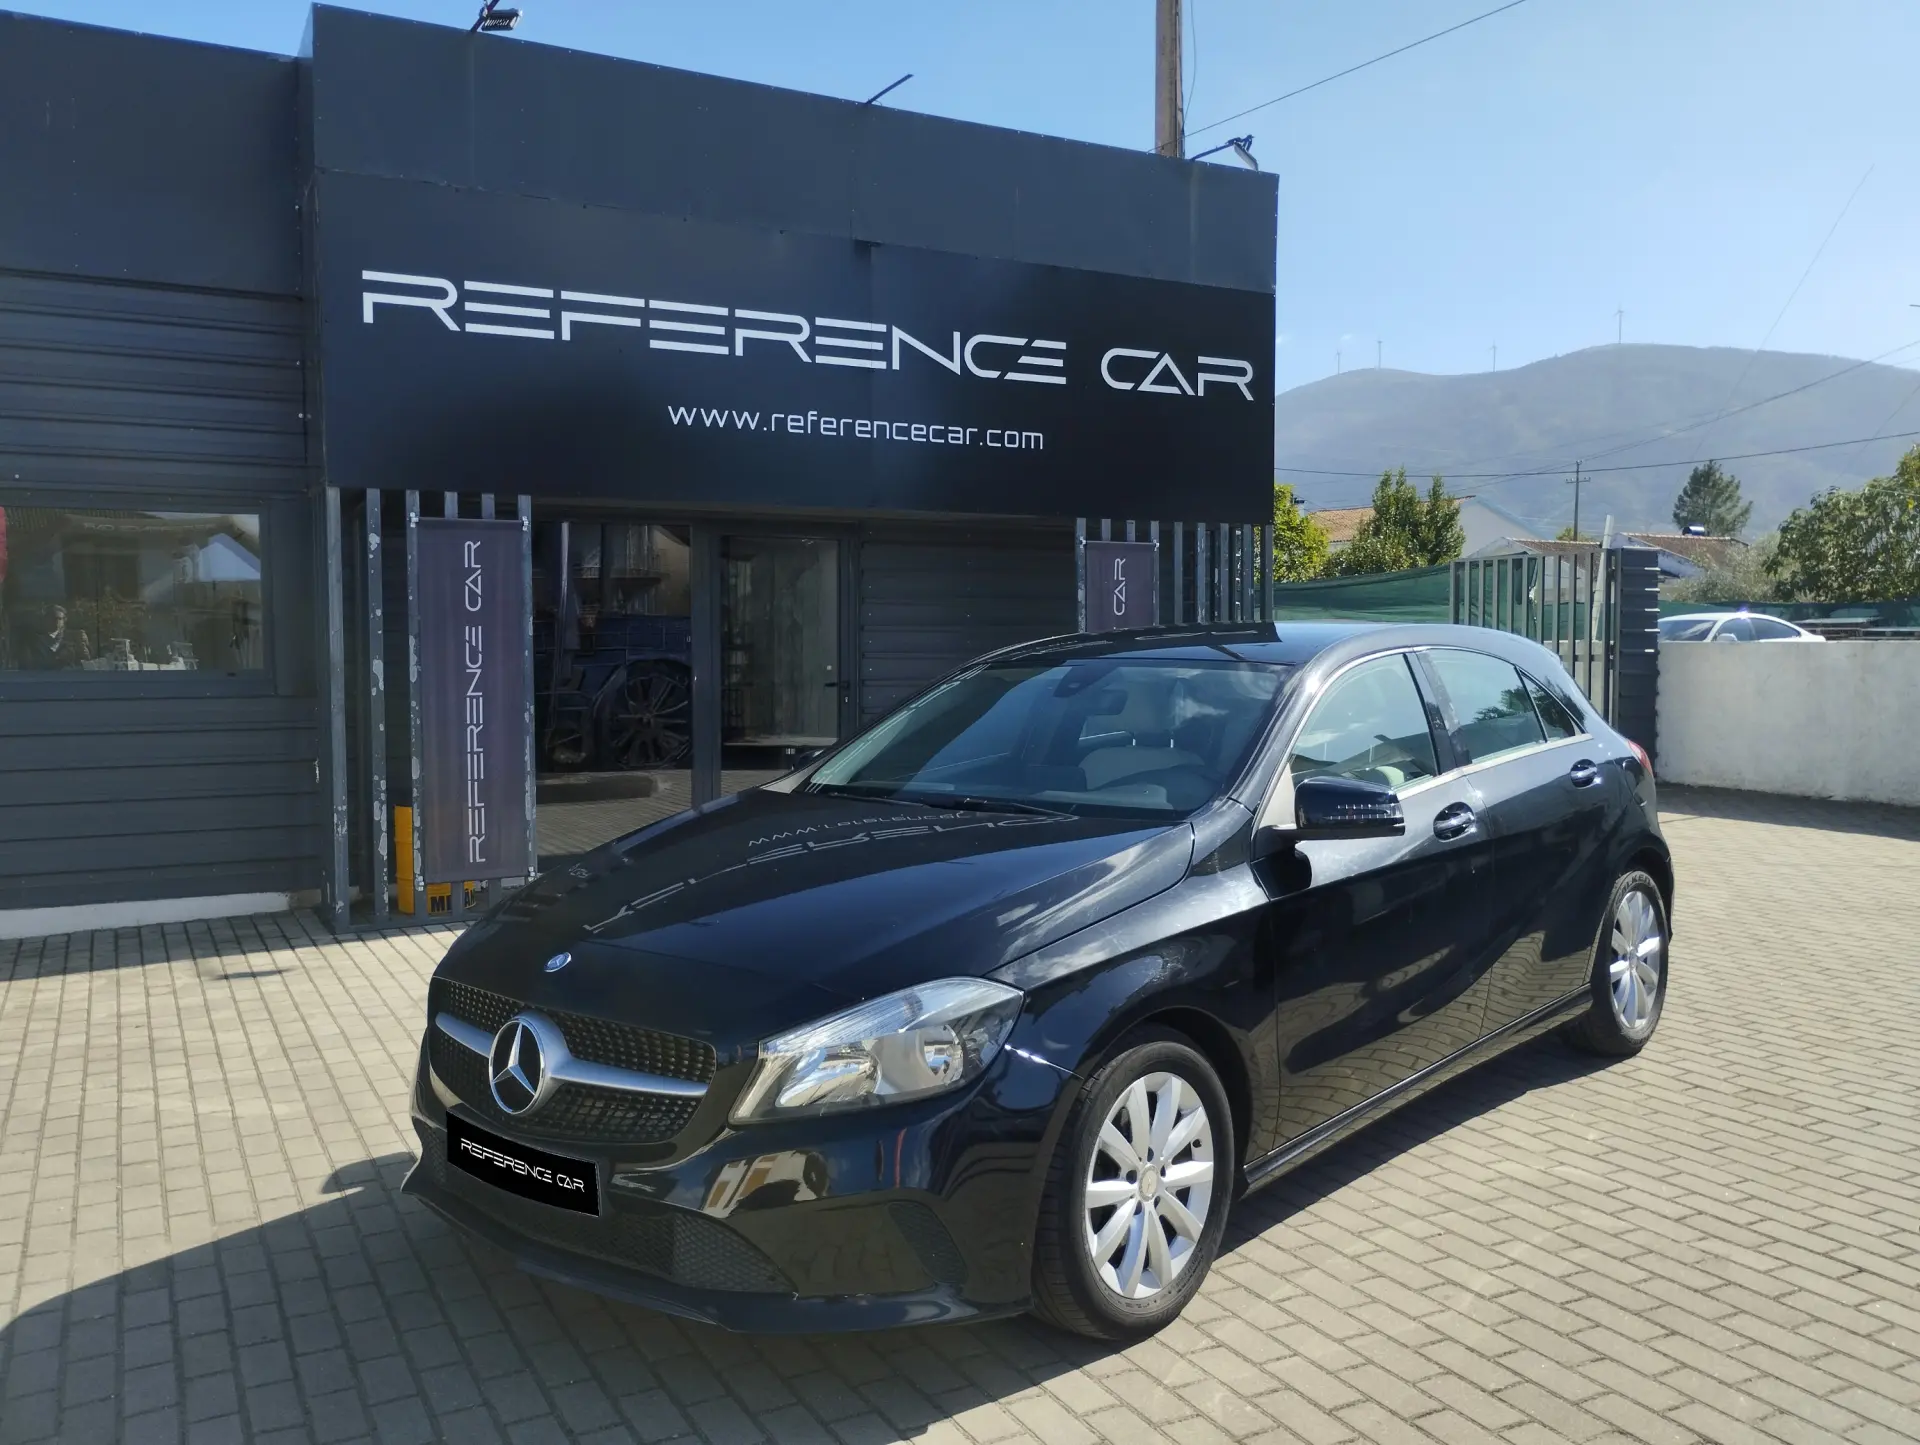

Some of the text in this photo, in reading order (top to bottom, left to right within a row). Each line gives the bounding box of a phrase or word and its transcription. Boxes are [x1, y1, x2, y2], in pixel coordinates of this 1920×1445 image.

[361, 269, 1254, 401] REFERENCE CAR
[667, 404, 1044, 451] www.referencecar.com
[1113, 558, 1126, 616] CAR
[464, 539, 487, 864] REFERENCE CAR
